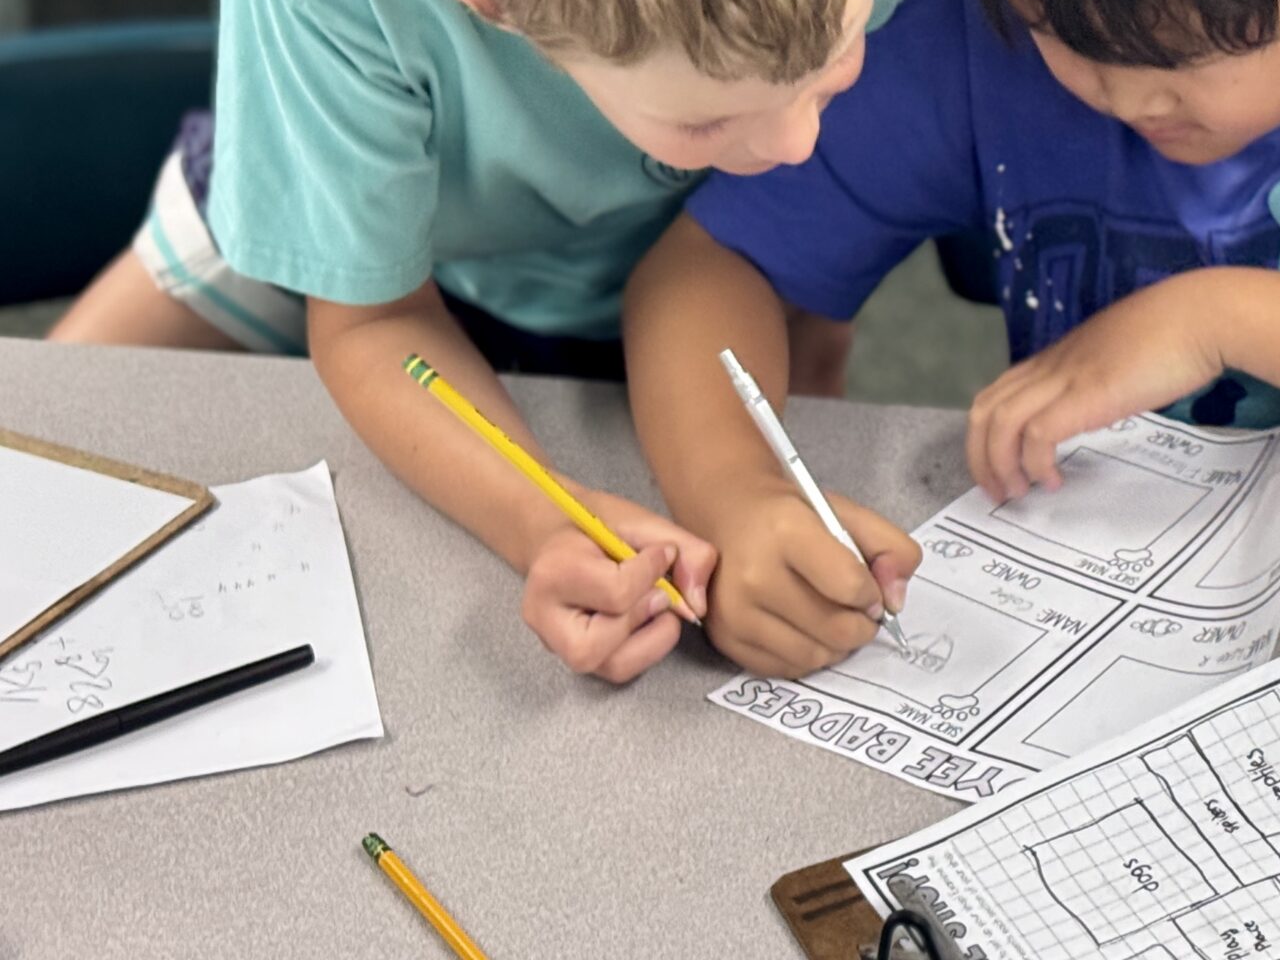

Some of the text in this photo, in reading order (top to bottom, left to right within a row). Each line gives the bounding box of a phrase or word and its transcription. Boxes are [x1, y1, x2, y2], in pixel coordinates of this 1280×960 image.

[980, 558, 1042, 590] OWNER
[724, 678, 1023, 801] YEE BADGES
[1203, 798, 1240, 834] spiders
[1122, 857, 1159, 894] dogs
[1218, 927, 1250, 960] Play
[1242, 919, 1271, 952] Place
